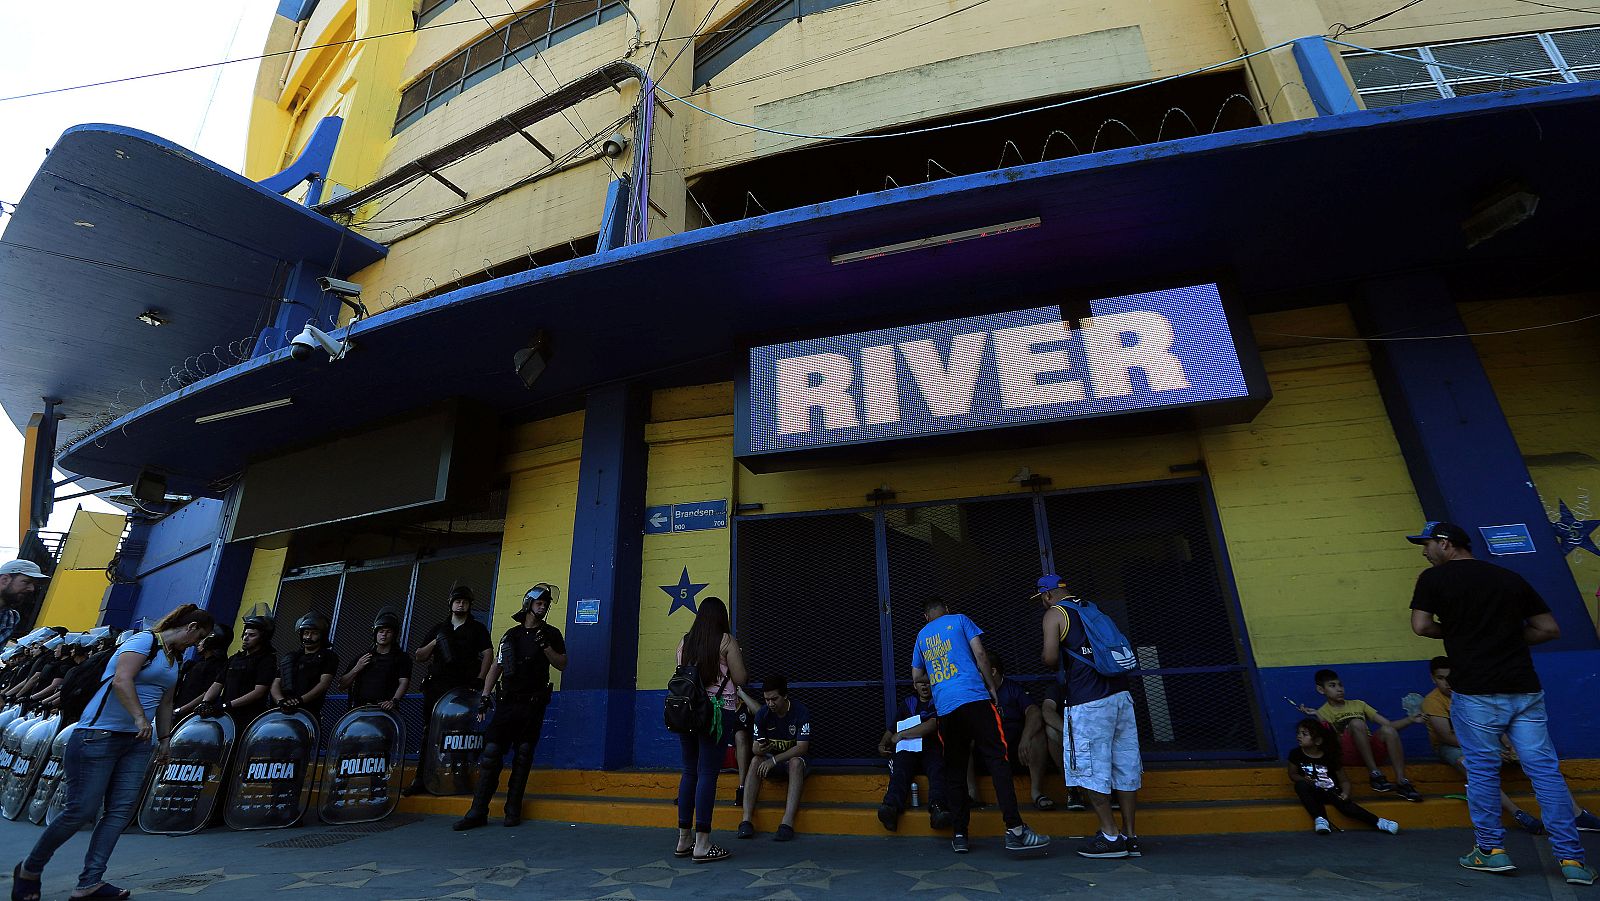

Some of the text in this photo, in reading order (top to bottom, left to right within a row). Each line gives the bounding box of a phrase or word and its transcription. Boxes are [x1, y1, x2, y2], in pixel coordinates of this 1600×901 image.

[776, 309, 1190, 436] RIVER
[675, 508, 714, 520] Brandsen
[680, 588, 688, 599] 5
[930, 663, 958, 685] BOCA
[932, 660, 942, 672] ES
[443, 734, 484, 750] POLICIA
[247, 762, 295, 779] POLICIA
[340, 757, 386, 775] POLICIA
